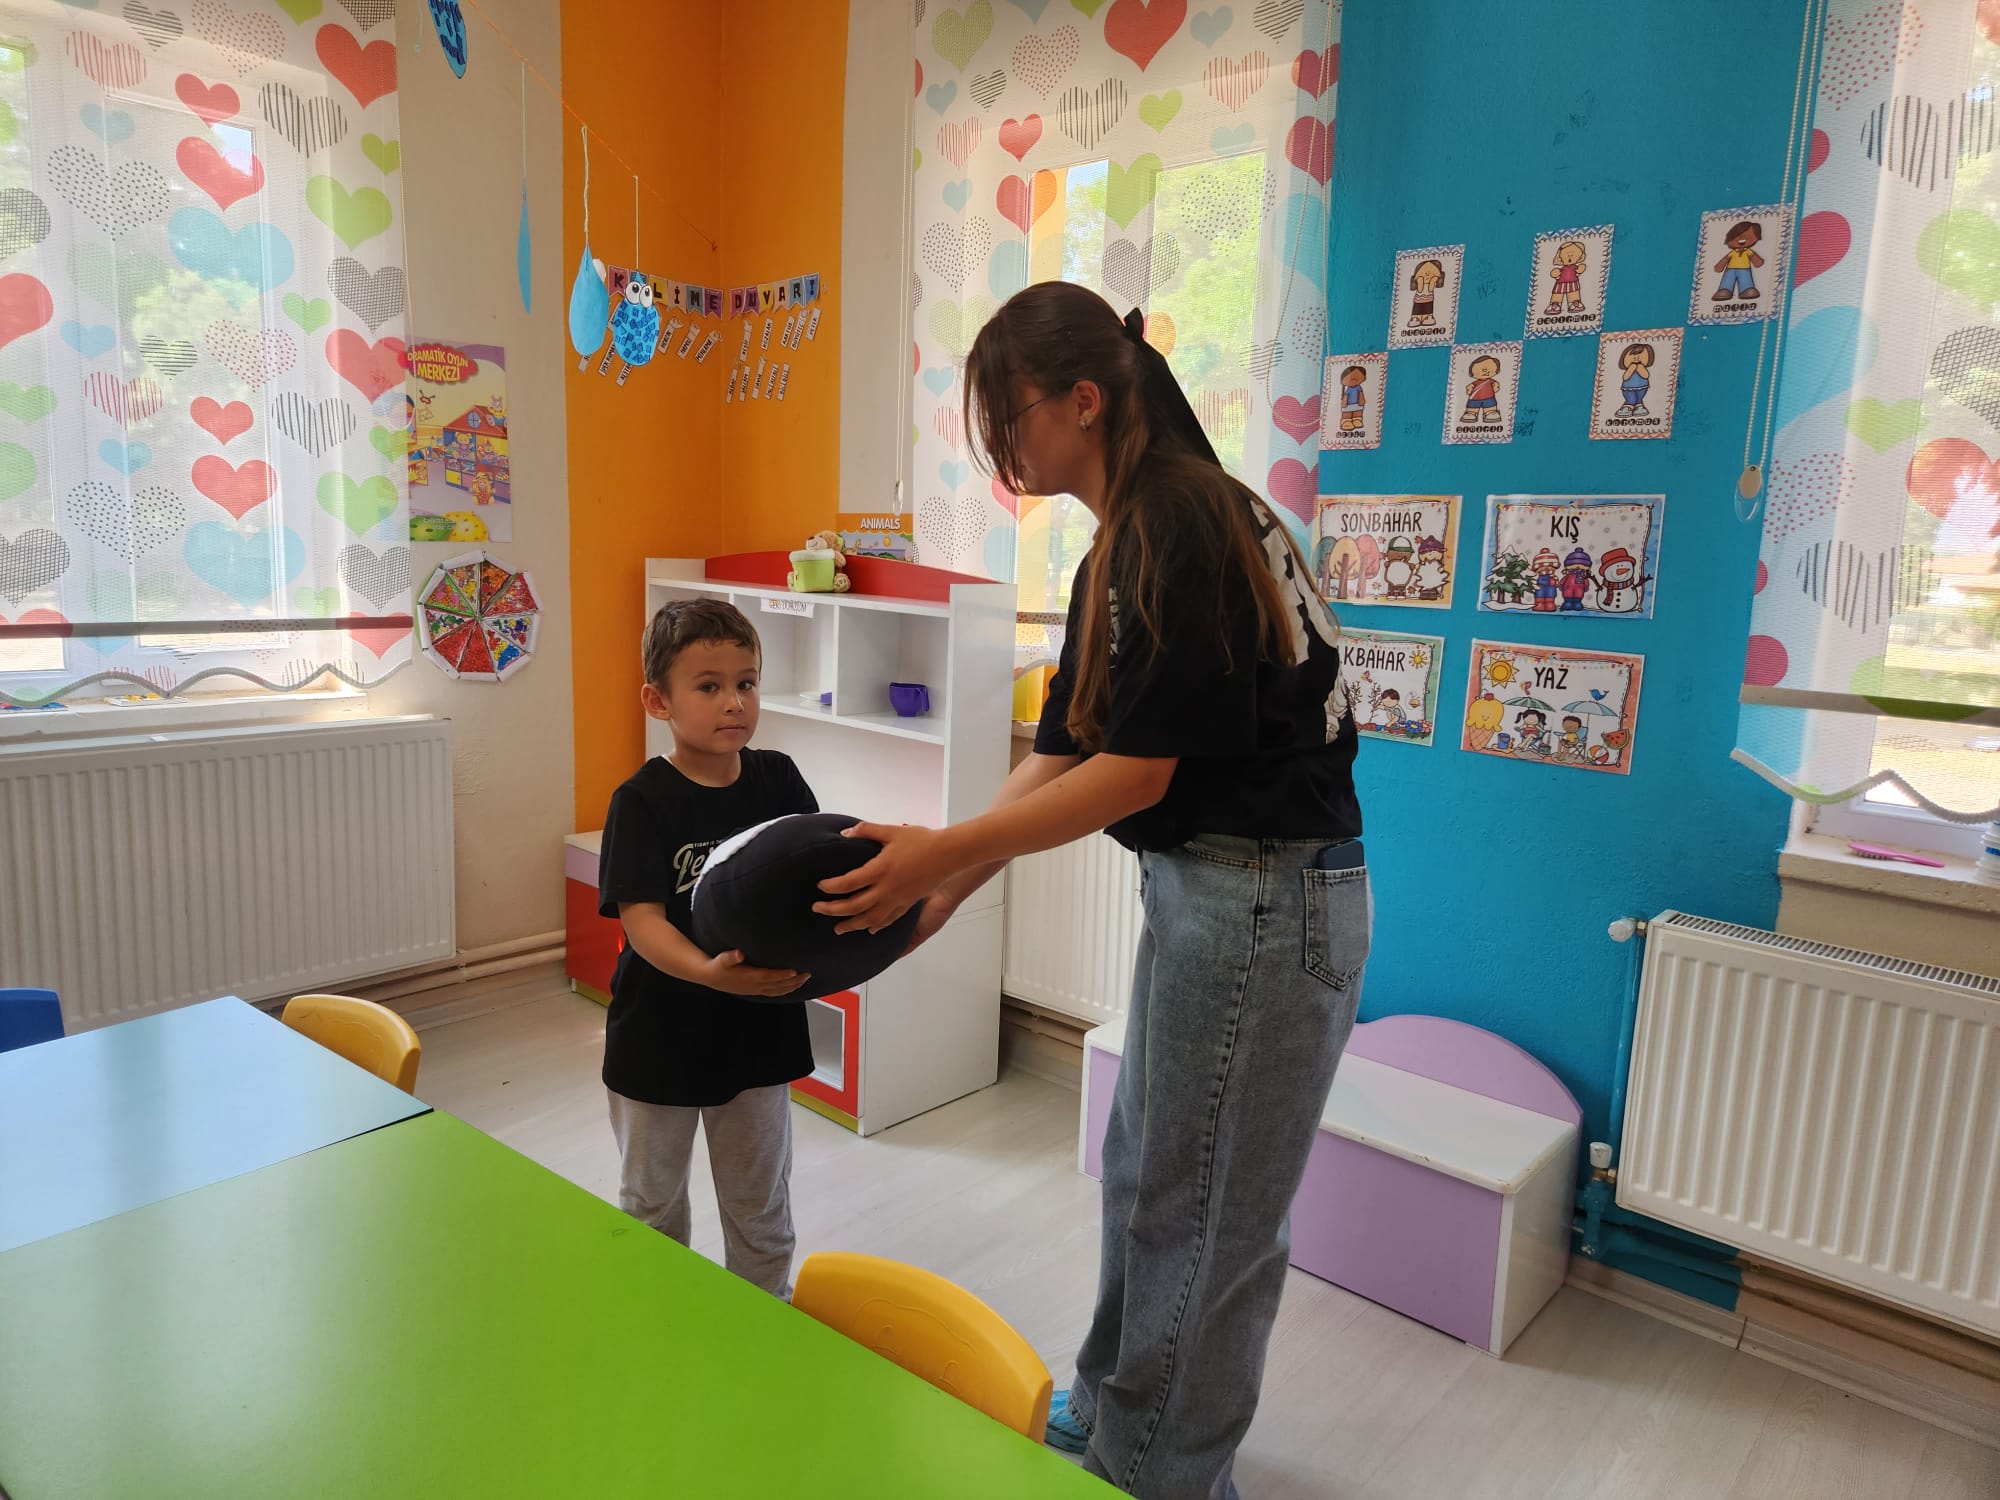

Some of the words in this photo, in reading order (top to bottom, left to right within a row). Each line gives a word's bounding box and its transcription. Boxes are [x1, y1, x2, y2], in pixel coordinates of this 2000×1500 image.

[407, 348, 445, 363] DRAMATİK
[447, 352, 468, 368] OYUN
[861, 517, 901, 530] ANIMALS
[1341, 511, 1422, 533] SONBAHAR
[1550, 515, 1580, 543] KIŞ
[1344, 646, 1406, 672] KBAHAR
[1534, 666, 1569, 689] YAZ
[673, 843, 714, 895] Le
